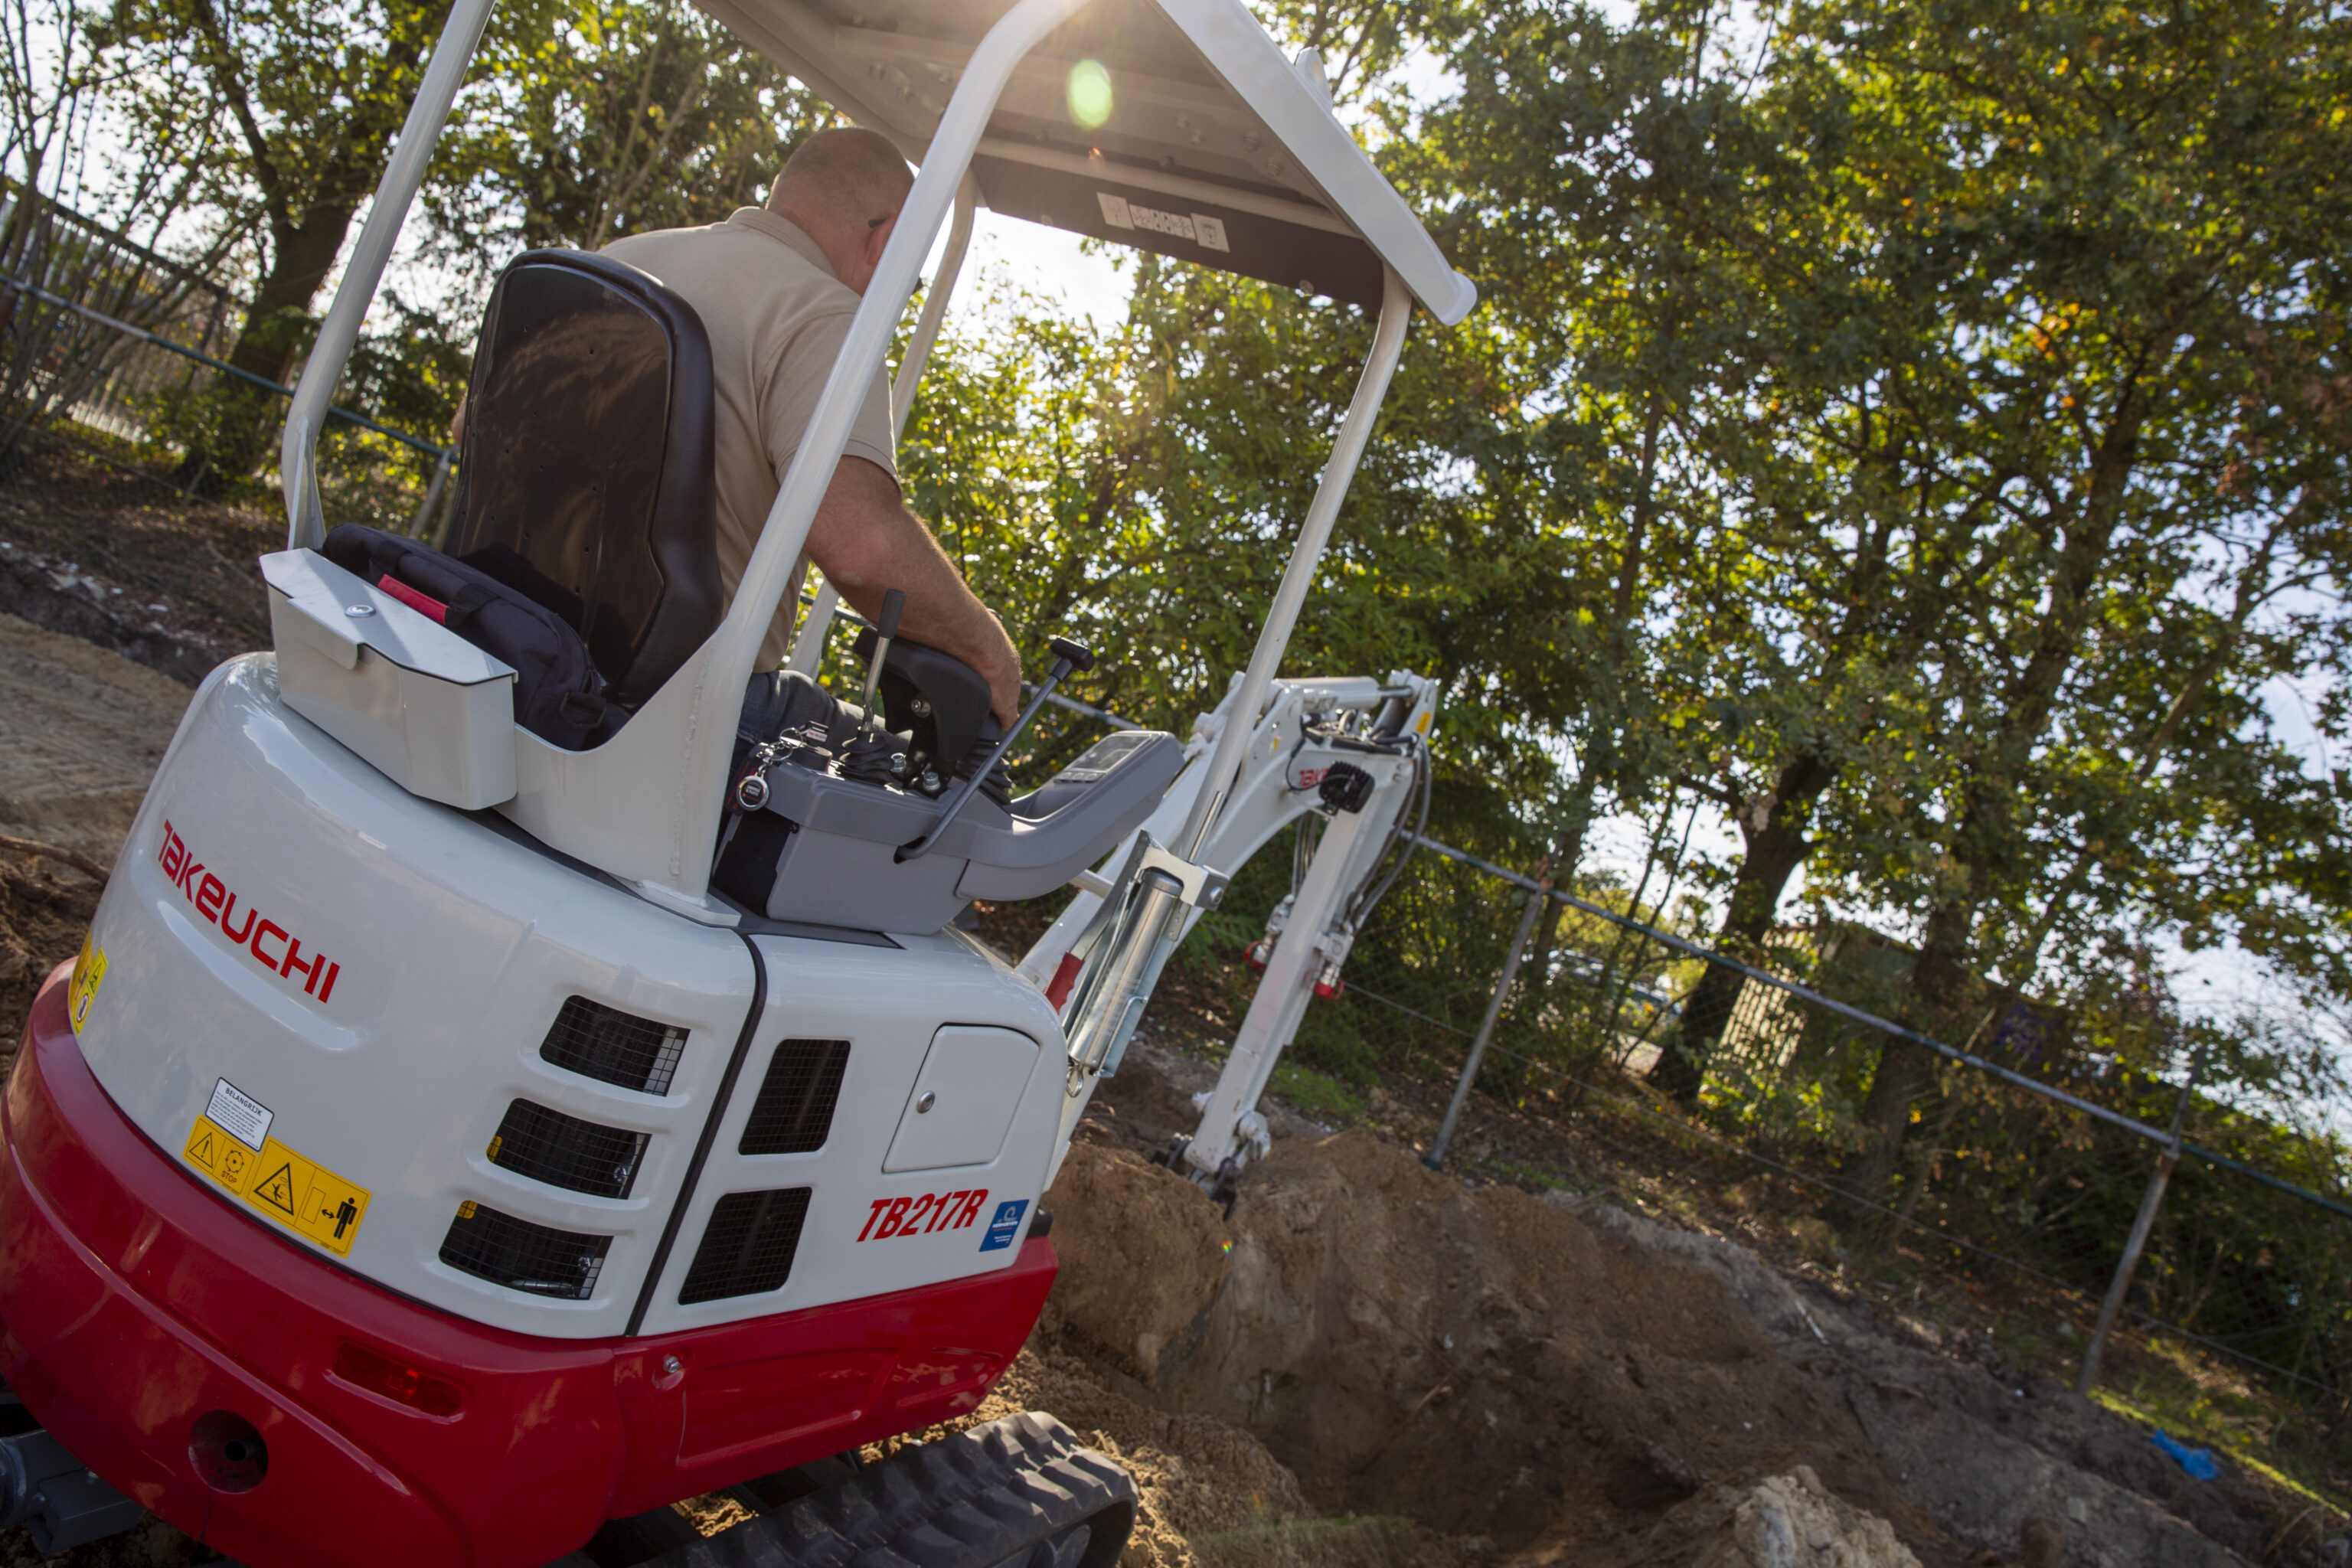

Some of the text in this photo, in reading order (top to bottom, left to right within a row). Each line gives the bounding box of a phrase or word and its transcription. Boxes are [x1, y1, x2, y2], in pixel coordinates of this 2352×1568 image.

[225, 1087, 263, 1116] BELANGRIJK
[220, 1170, 237, 1184] STOP
[856, 1189, 988, 1243] TB217R
